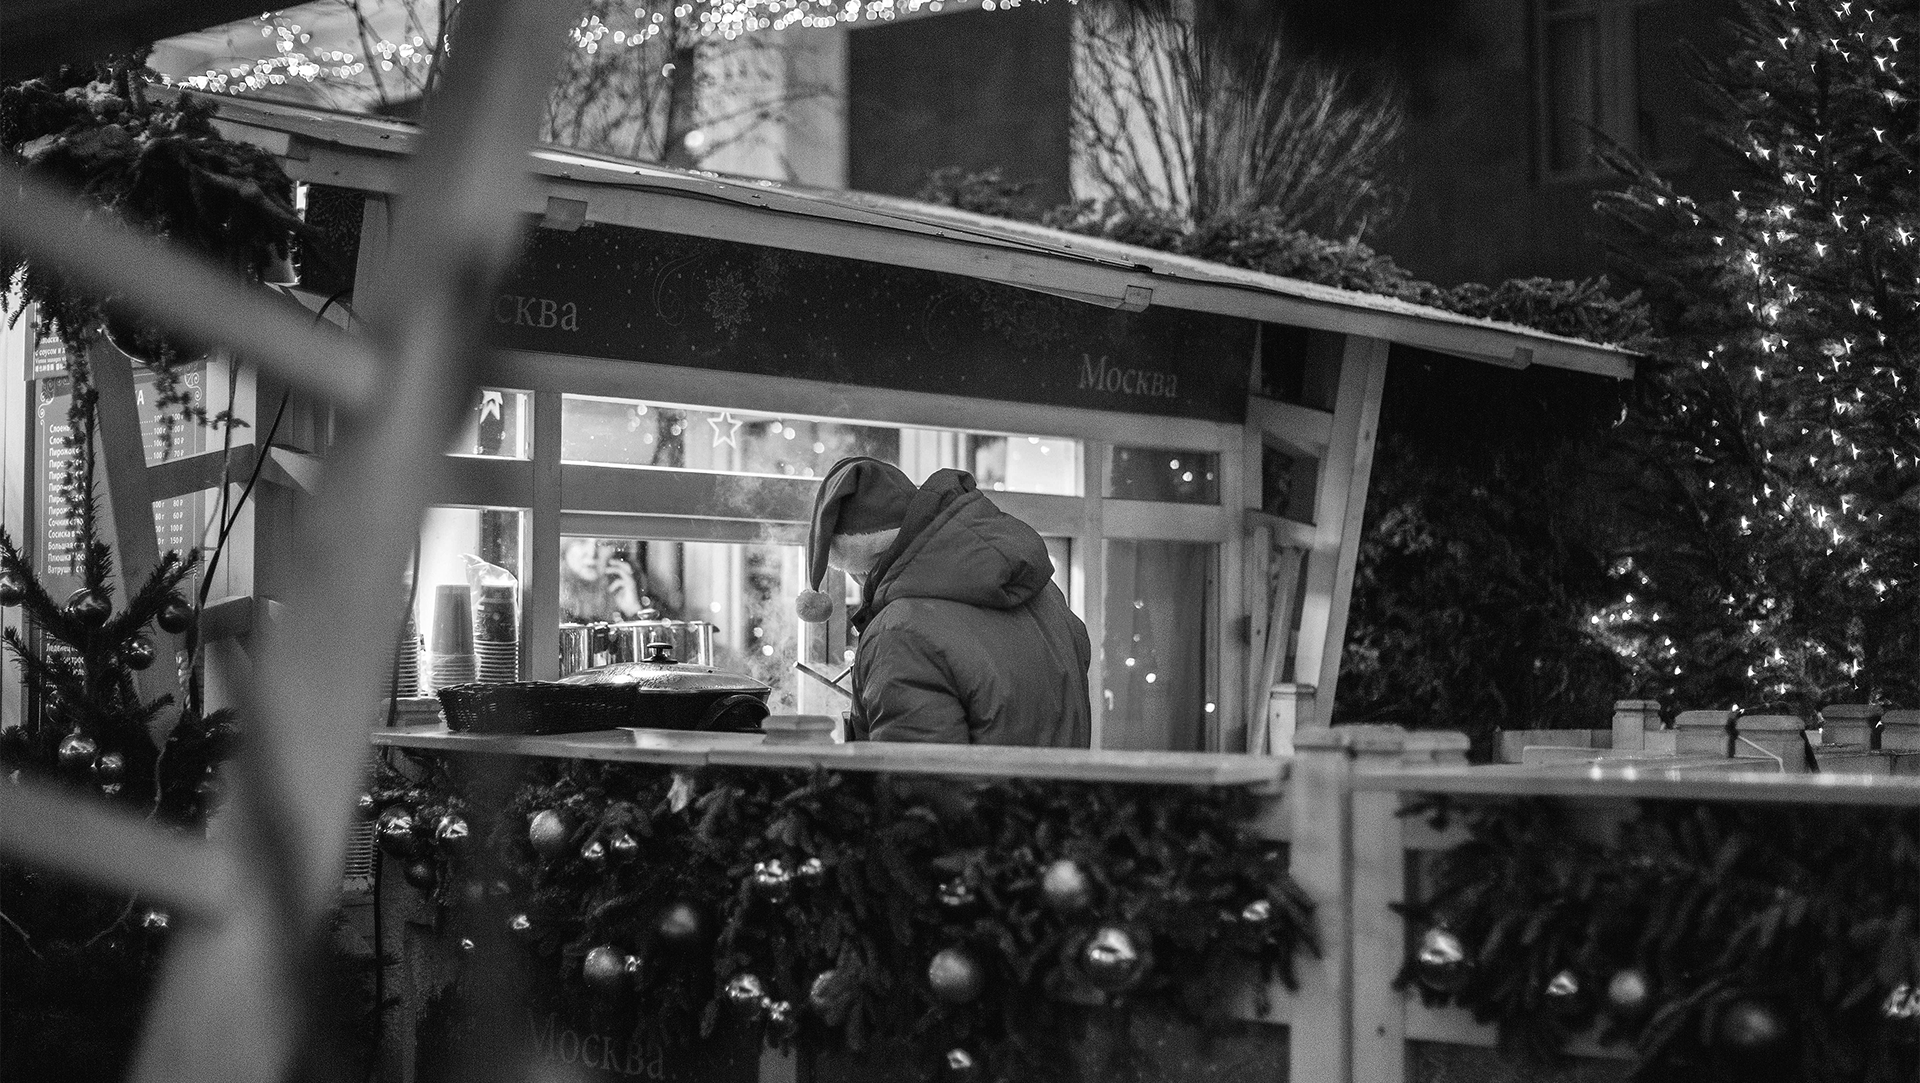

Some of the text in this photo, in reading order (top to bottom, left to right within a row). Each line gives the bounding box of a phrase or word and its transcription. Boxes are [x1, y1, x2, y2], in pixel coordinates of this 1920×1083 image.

[495, 294, 579, 332] сква
[1078, 353, 1177, 398] Москва
[48, 565, 72, 575] Ватруш
[521, 1007, 666, 1080] Москва
